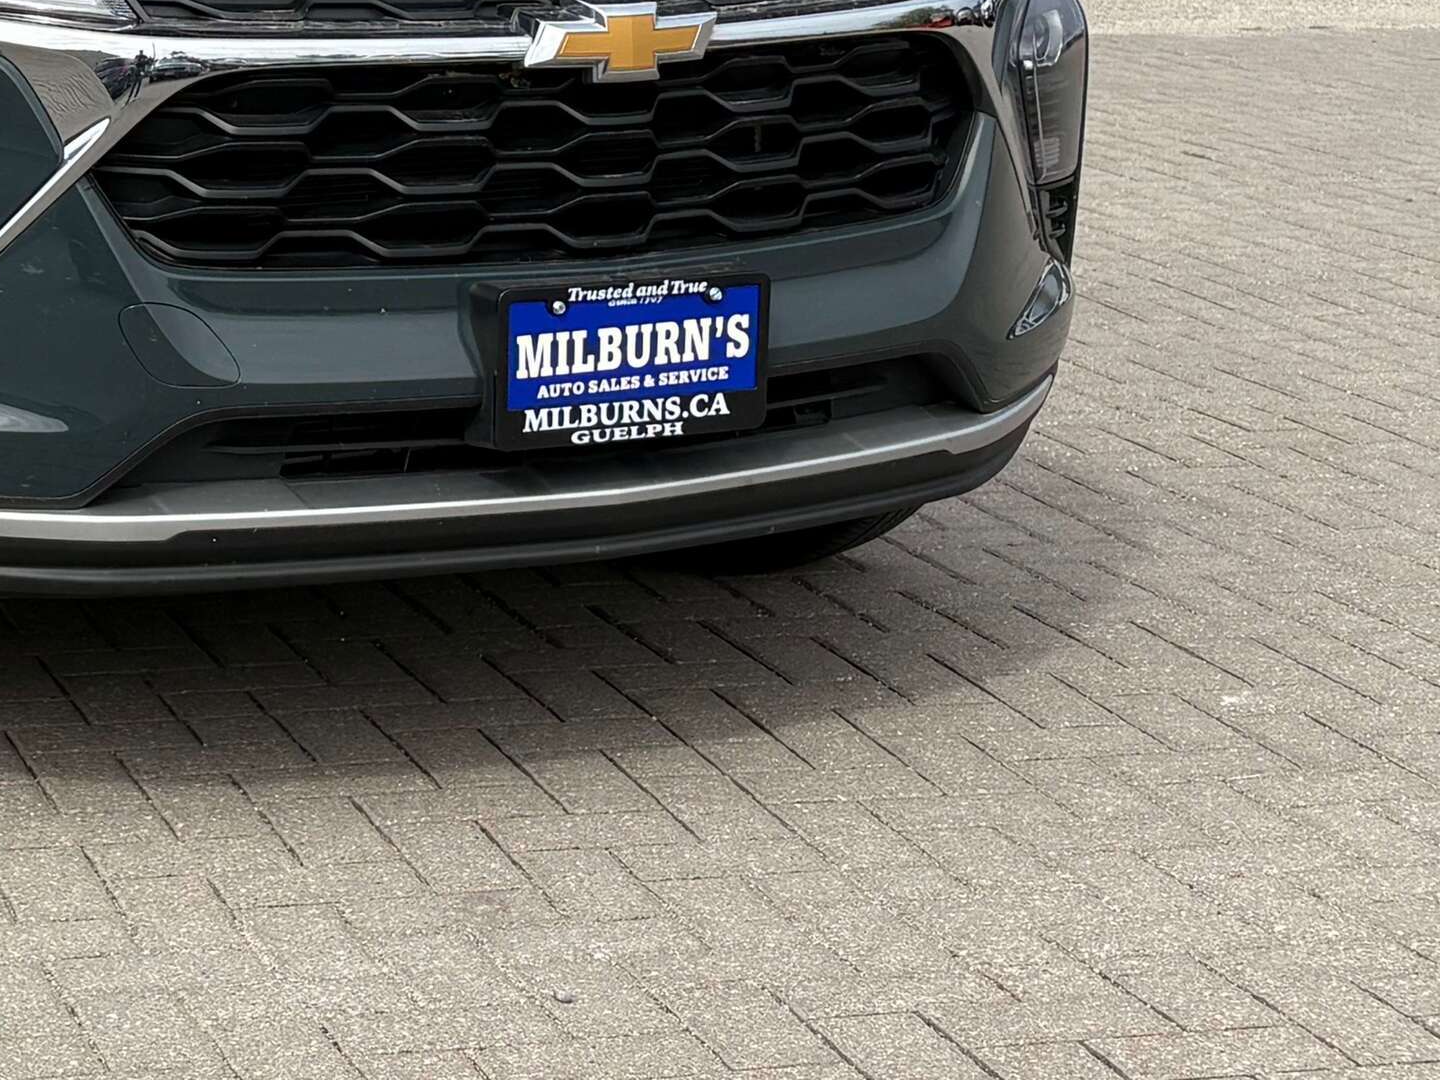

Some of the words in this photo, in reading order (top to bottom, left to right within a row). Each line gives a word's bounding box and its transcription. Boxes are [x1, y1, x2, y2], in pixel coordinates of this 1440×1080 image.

[567, 282, 633, 302] Trusted
[636, 279, 668, 298] and
[670, 280, 708, 295] True
[516, 313, 750, 380] MILBURN'S
[537, 381, 585, 399] AUTO
[588, 376, 640, 393] SALES
[643, 375, 656, 388] &
[659, 366, 729, 386] SERVICE
[522, 392, 730, 433] MILBURNS.CA
[571, 421, 684, 444] GUELPH
